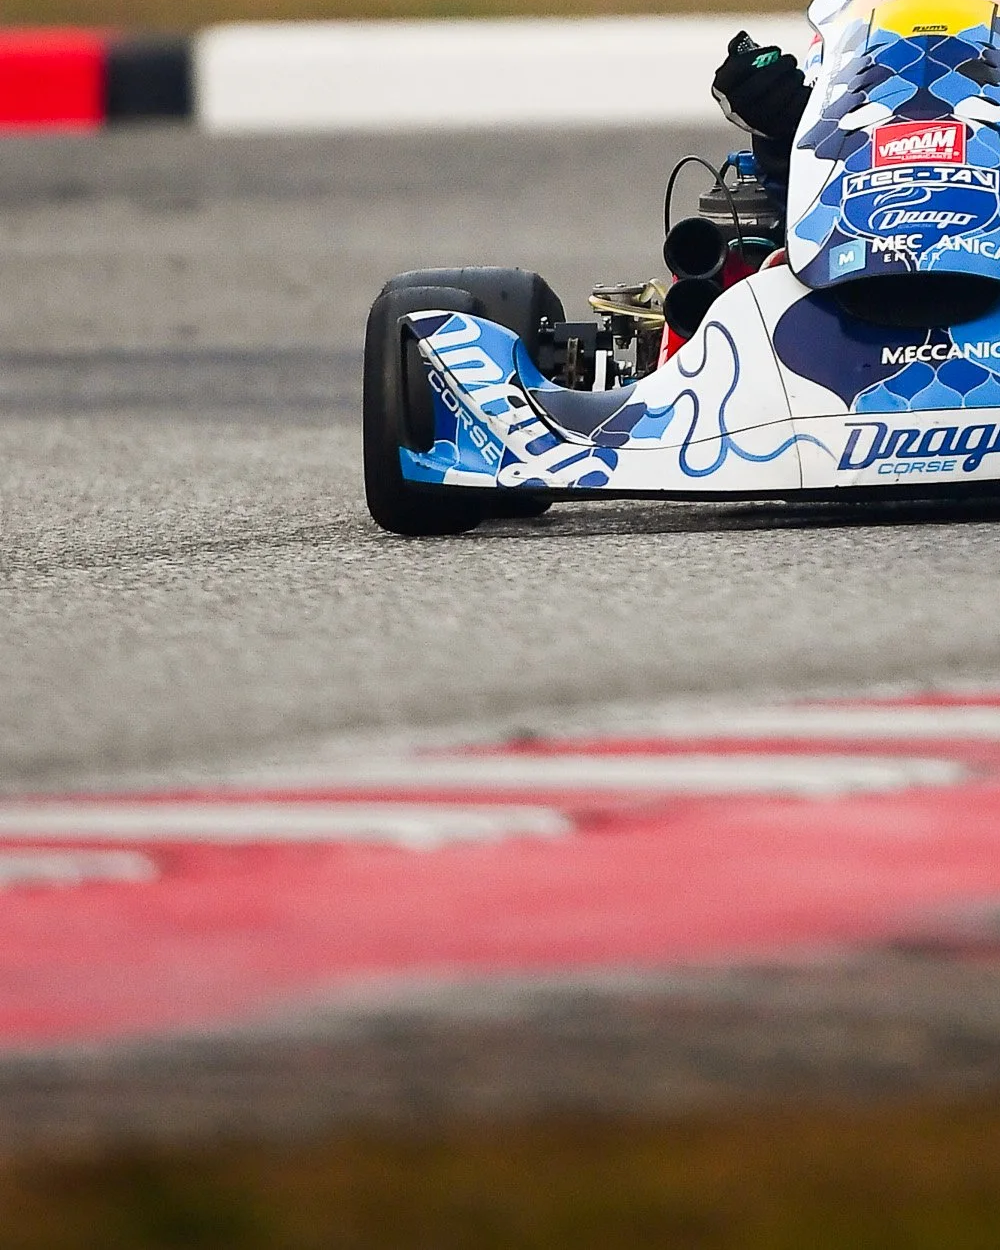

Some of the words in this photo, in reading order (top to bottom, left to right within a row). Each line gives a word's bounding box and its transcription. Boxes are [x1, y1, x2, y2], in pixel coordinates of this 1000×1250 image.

[878, 209, 978, 231] Drago
[427, 368, 500, 466] CORSE
[877, 459, 957, 475] CORSE
